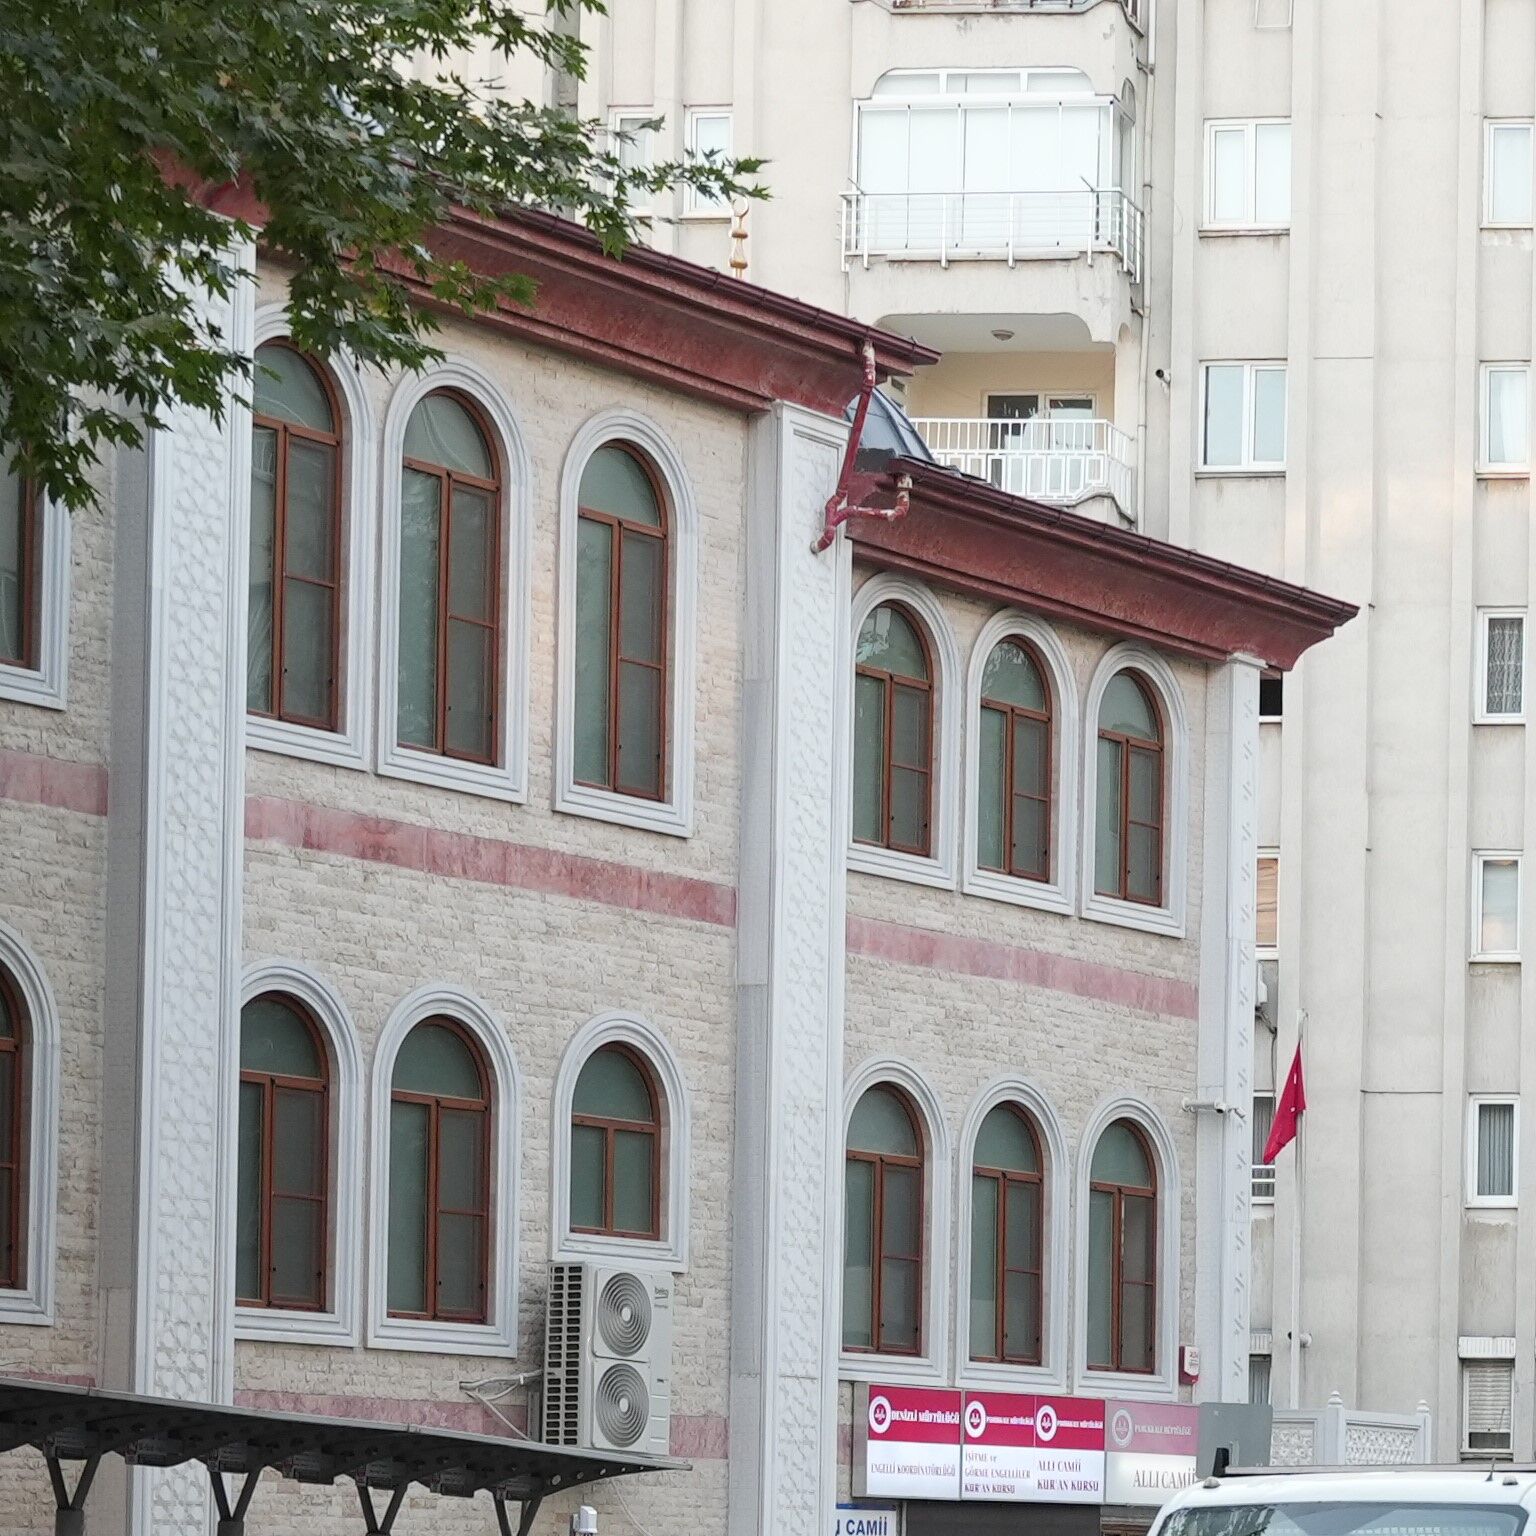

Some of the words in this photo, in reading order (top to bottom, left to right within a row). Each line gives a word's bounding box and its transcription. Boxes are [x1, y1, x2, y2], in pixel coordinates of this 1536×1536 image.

[1058, 1459, 1081, 1472] CAMİİ
[1071, 1480, 1099, 1492] KURSU
[1132, 1470, 1159, 1488] ALLI
[846, 1516, 887, 1536] CAMİİ
